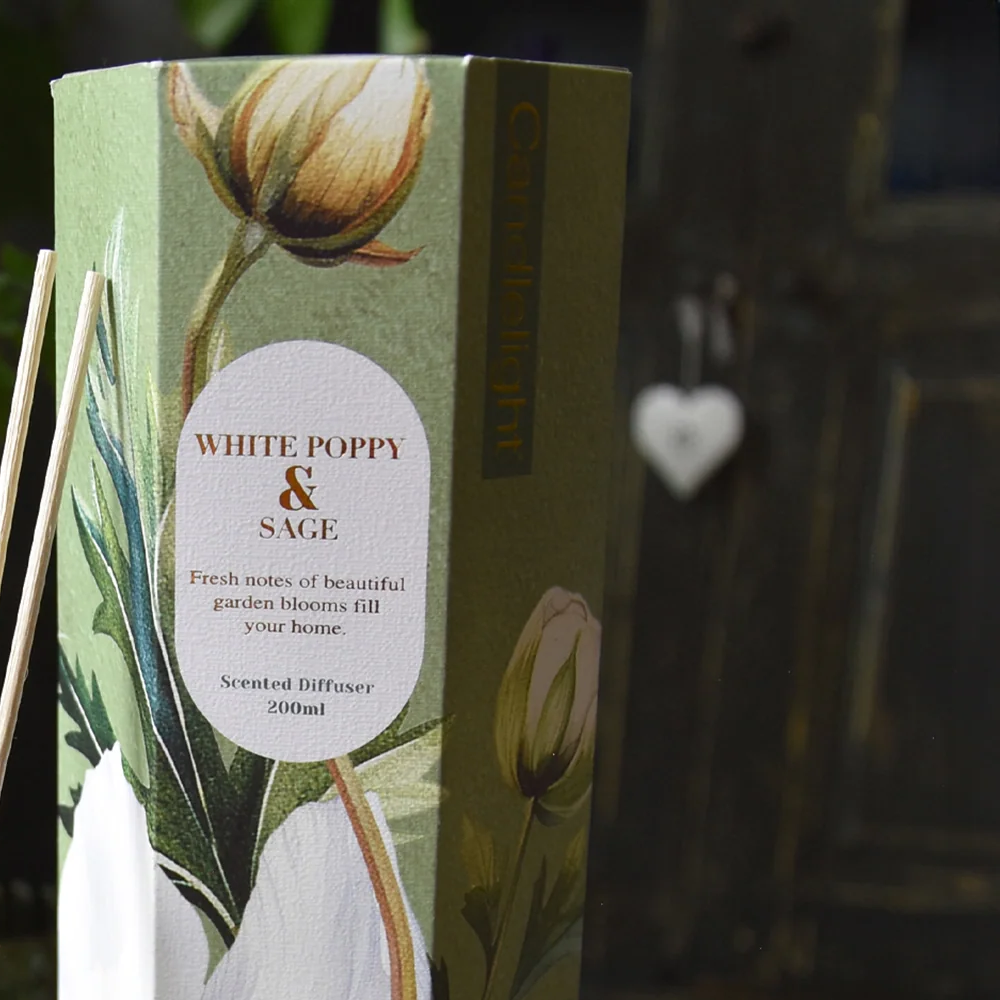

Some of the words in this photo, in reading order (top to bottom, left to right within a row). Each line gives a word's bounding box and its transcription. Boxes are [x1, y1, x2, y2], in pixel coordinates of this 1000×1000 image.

[194, 433, 298, 458] WHITE
[306, 435, 407, 460] POPPY
[278, 464, 319, 511] &
[259, 516, 339, 541] SAGE
[189, 570, 239, 587] Fresh
[245, 575, 293, 588] notes
[299, 574, 320, 589] of
[324, 574, 406, 592] beautiful
[213, 595, 275, 613] garden
[280, 596, 348, 613] blooms
[353, 598, 380, 614] fill
[244, 620, 286, 636] your
[291, 620, 347, 636] home.
[220, 674, 292, 692] Scented
[299, 677, 375, 694] Diffuser
[267, 699, 326, 716] 200ml
